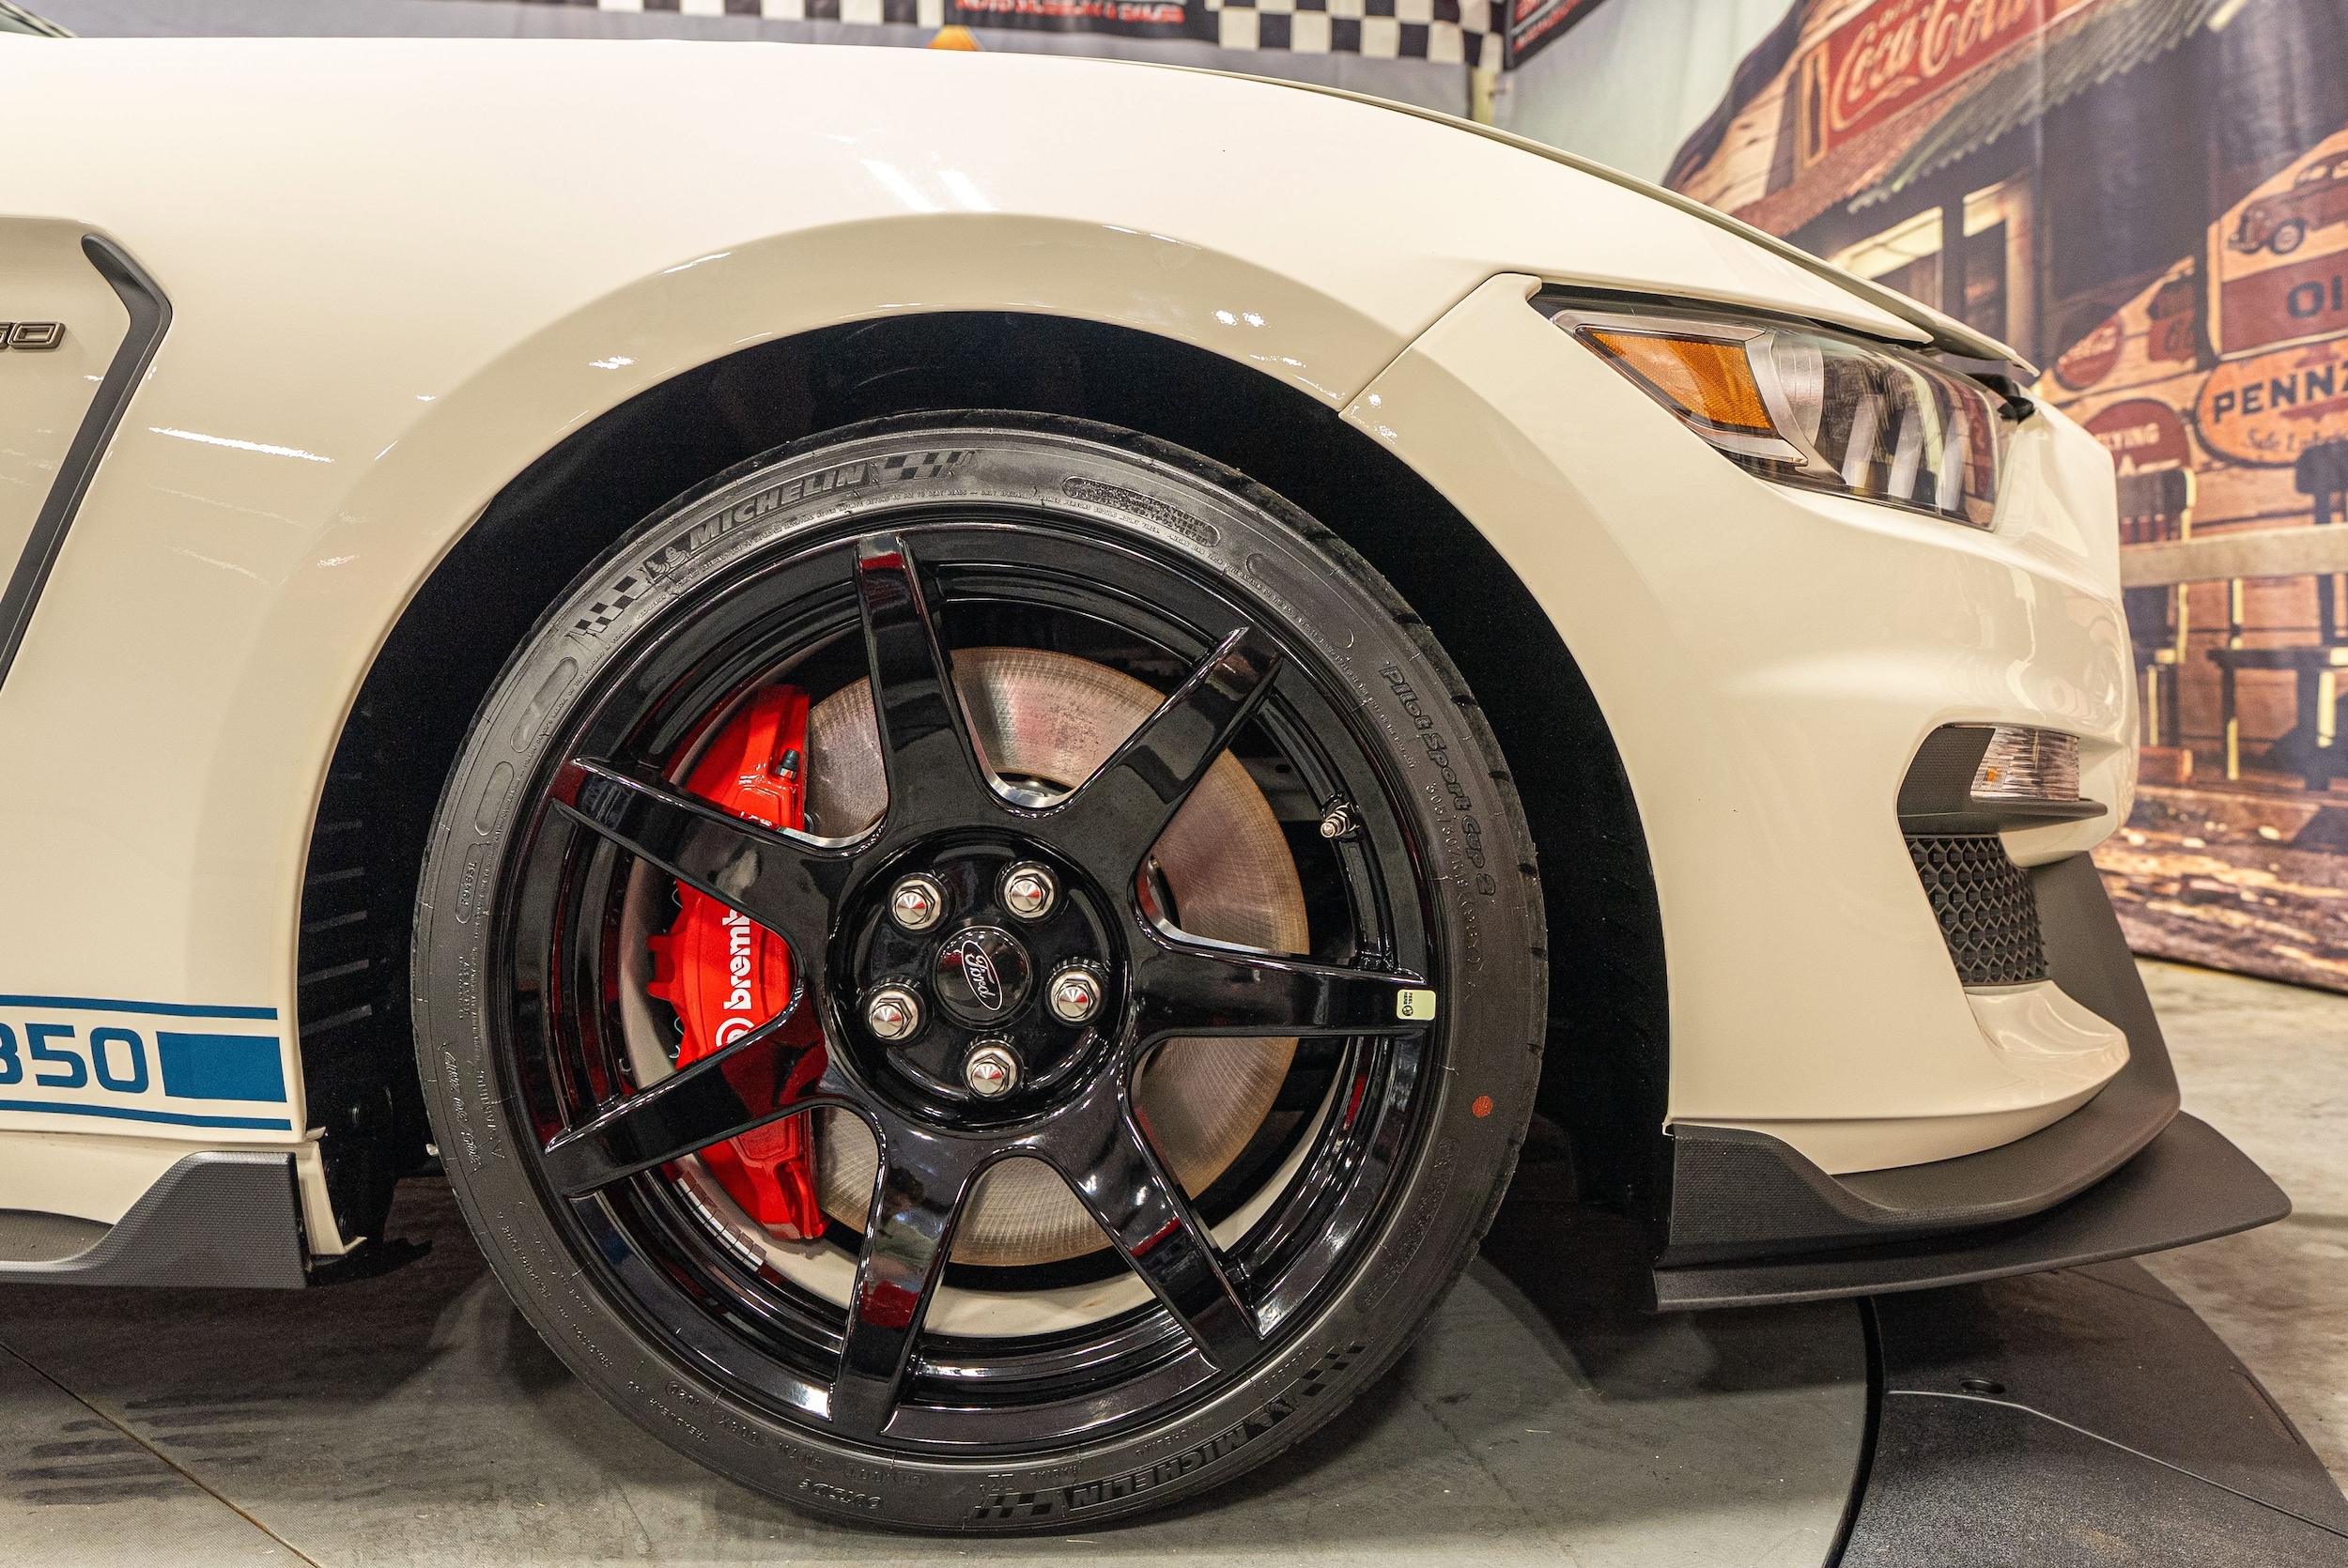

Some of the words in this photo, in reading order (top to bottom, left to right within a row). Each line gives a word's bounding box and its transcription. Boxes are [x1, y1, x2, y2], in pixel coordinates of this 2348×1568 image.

[691, 463, 869, 549] MICHELIN
[1475, 873, 1496, 896] 2
[721, 908, 752, 1010] bremb
[965, 952, 996, 999] Ford
[1074, 1428, 1248, 1506] MICHELIN
